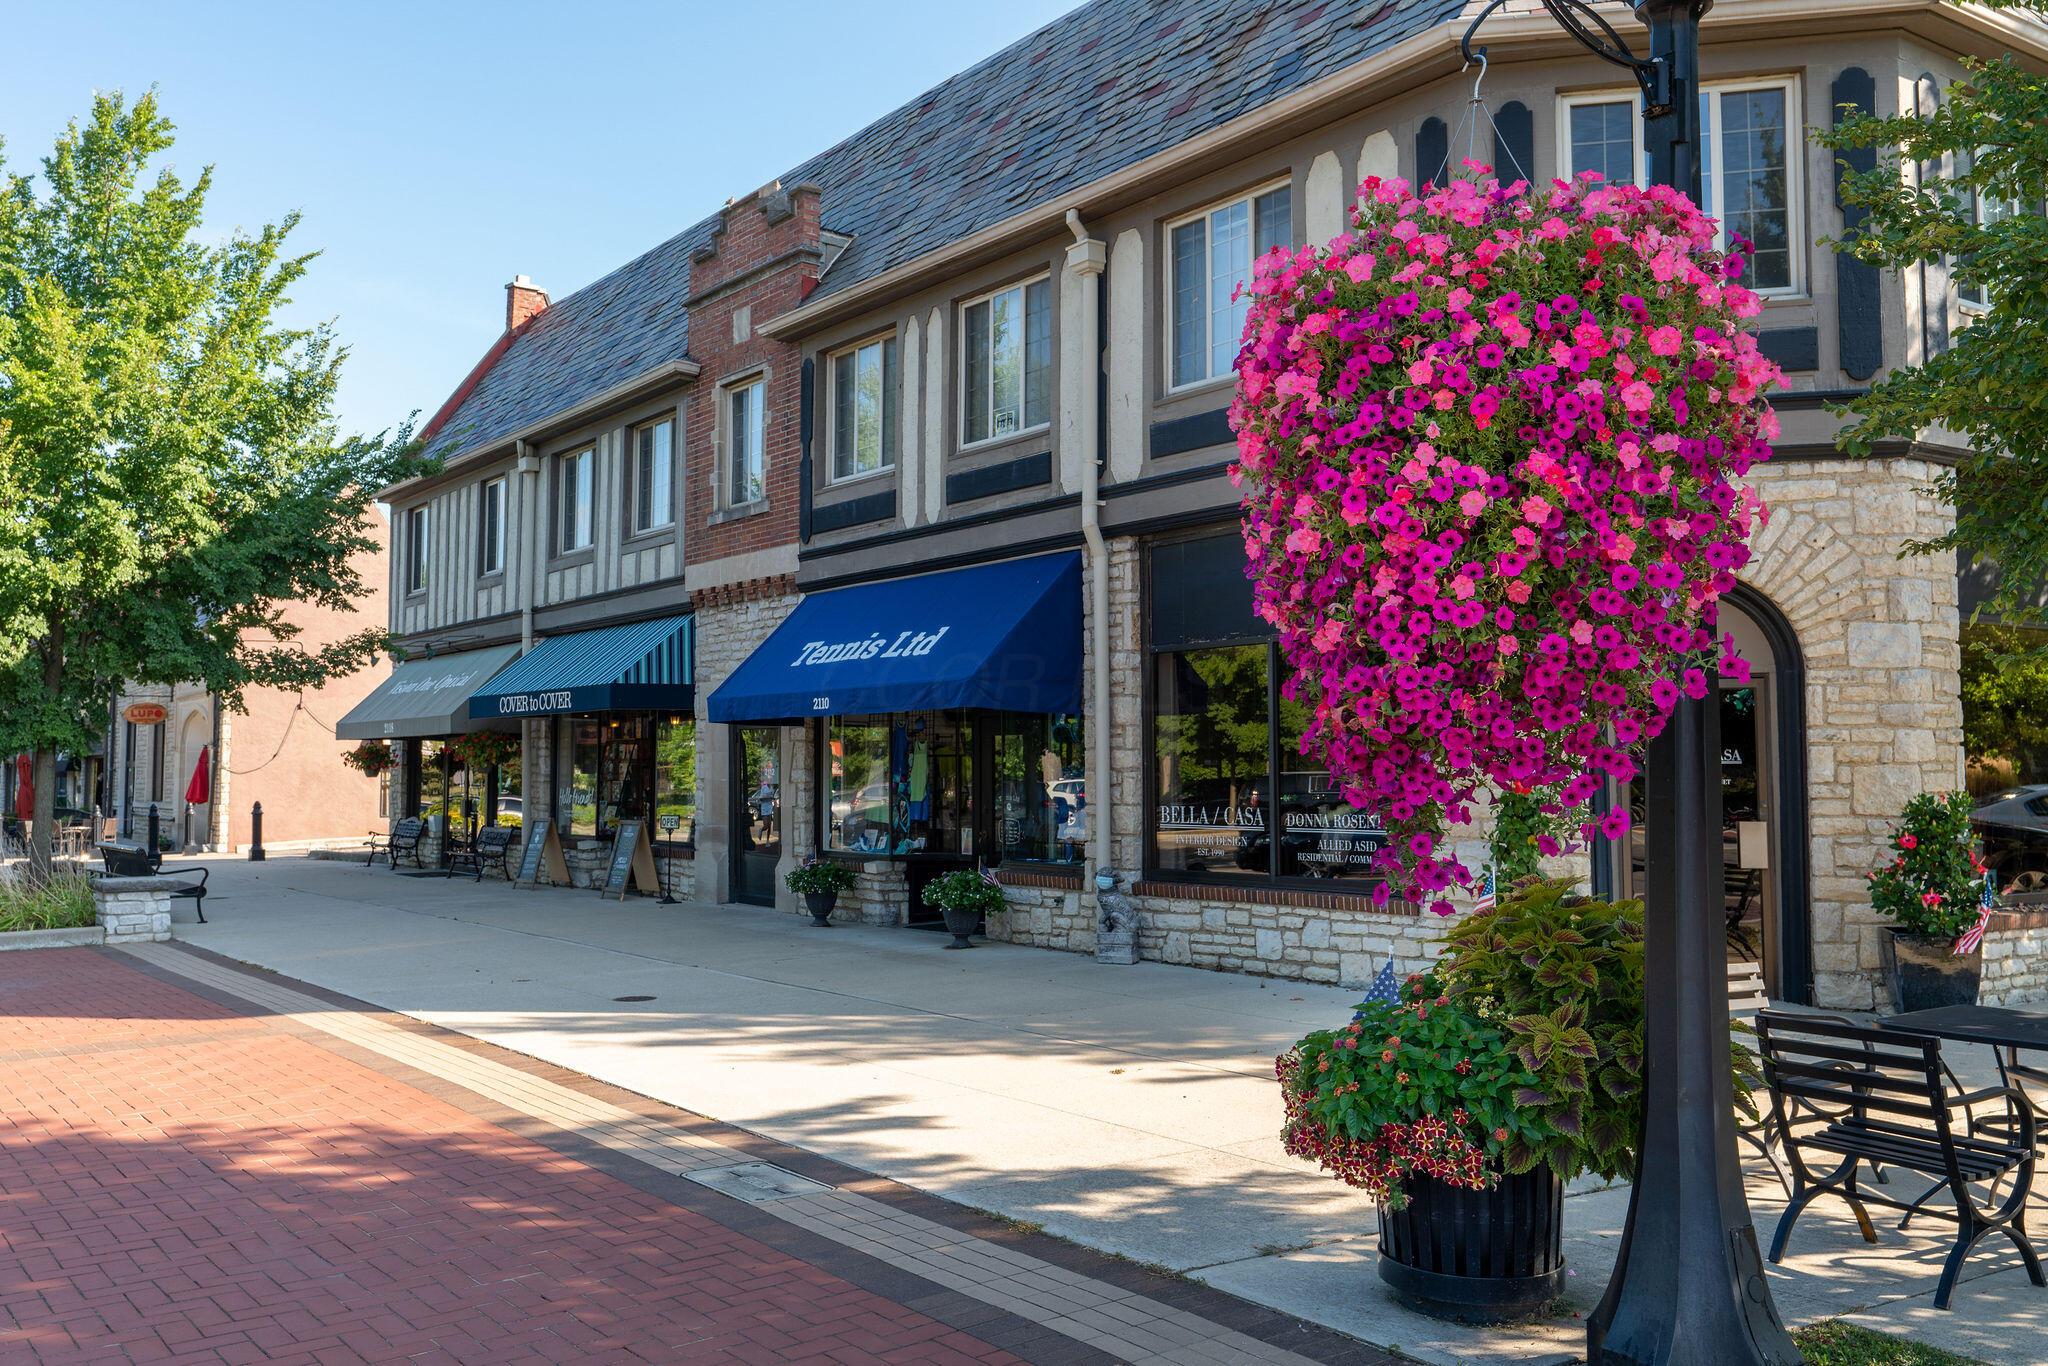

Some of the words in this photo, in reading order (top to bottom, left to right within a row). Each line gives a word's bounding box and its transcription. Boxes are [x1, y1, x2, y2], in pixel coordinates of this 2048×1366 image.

[790, 632, 887, 667] Tennis
[880, 626, 950, 659] Ltd
[499, 695, 529, 714] COVER
[529, 695, 539, 711] to
[539, 691, 572, 710] COVER
[813, 697, 830, 710] 2110
[662, 817, 679, 826] OPEN
[1160, 805, 1210, 825] BELLA
[1223, 806, 1265, 826] CASA
[1286, 813, 1330, 828] DONNA
[1176, 834, 1214, 846] INTERIOR
[1216, 835, 1248, 847] DESIGN
[1317, 839, 1352, 851] ALLIED
[1354, 841, 1377, 853] ASID
[1297, 853, 1343, 863] RESIDENTIAL
